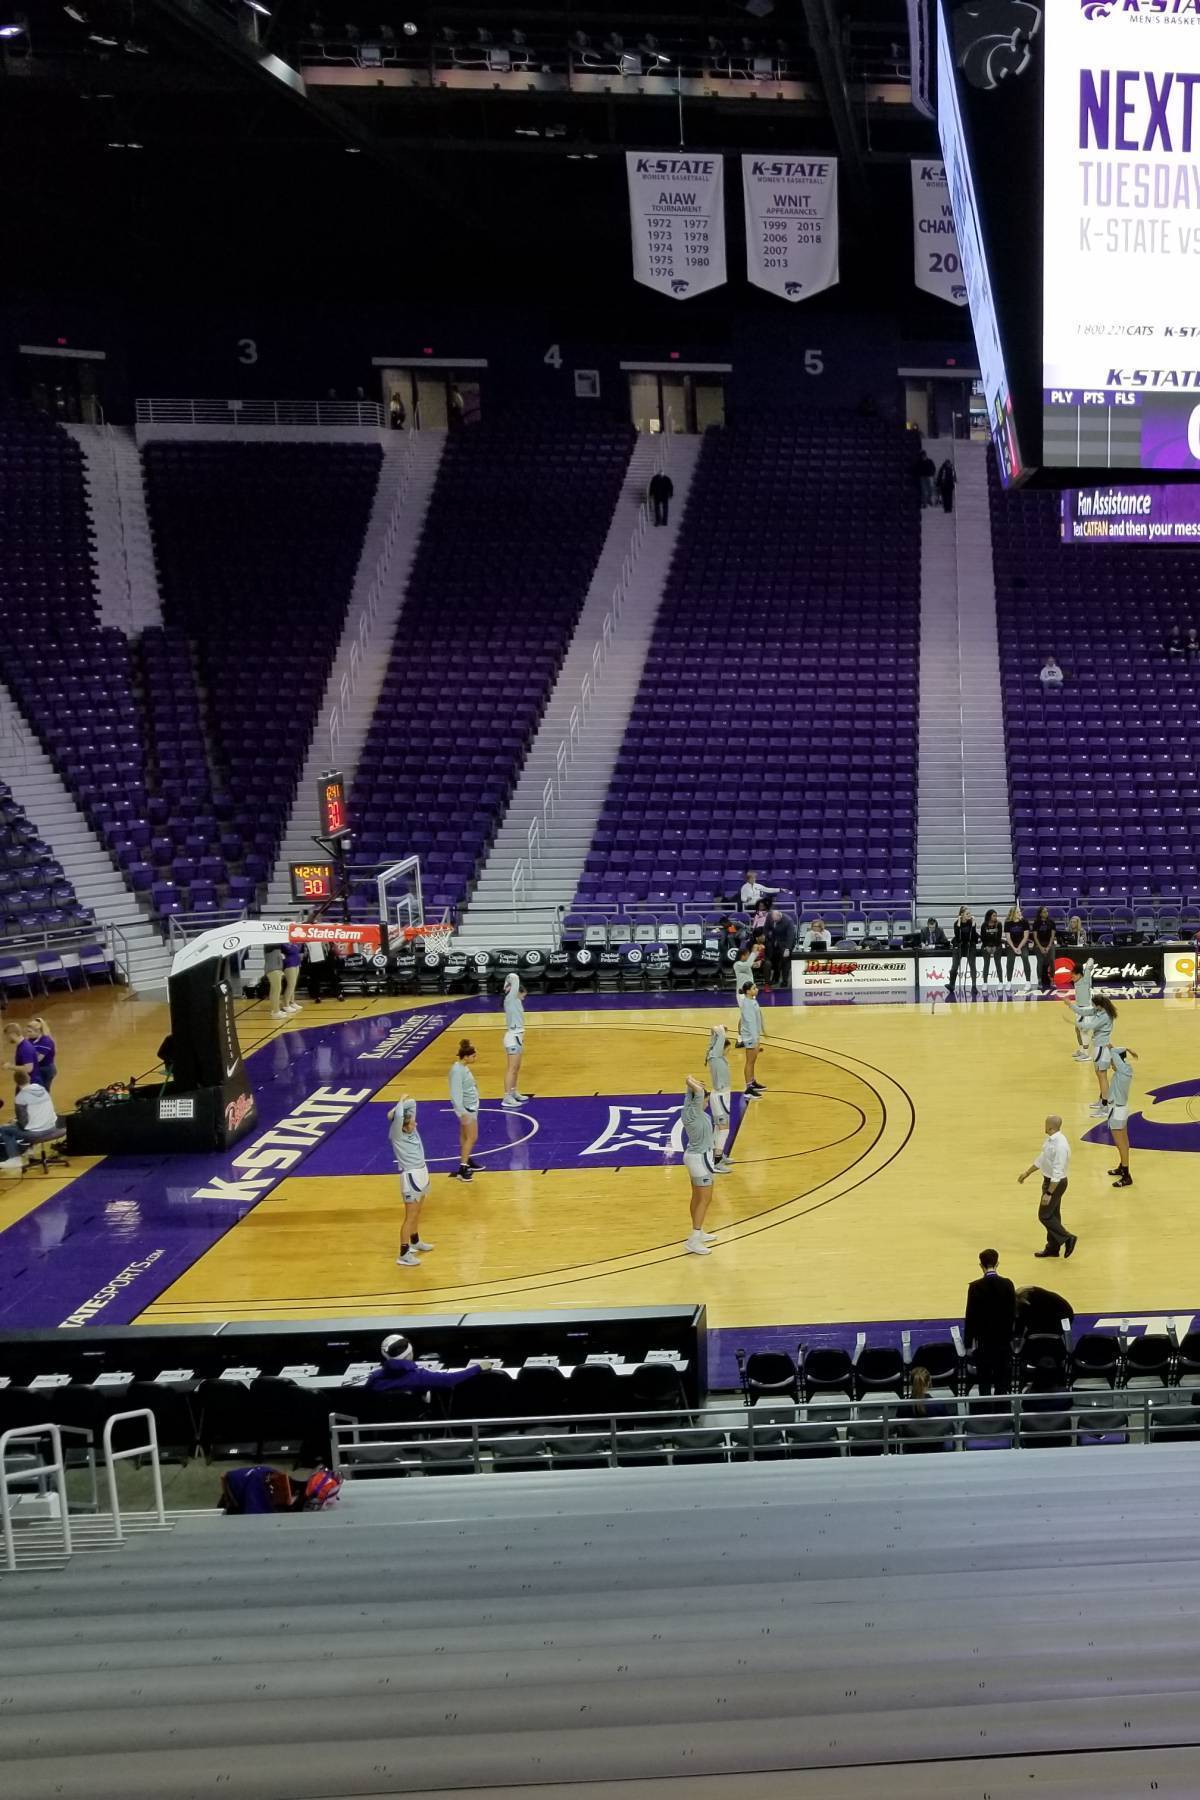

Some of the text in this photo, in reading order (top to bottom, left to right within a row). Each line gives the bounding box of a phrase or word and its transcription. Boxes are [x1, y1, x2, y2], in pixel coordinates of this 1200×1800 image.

[1130, 14, 1161, 24] MEN'S
[636, 159, 715, 175] K-STATE
[752, 161, 830, 177] K-STATE
[659, 192, 696, 205] AIAW
[773, 194, 812, 208] WNIT
[652, 205, 702, 213] TOURNAMENT
[766, 207, 818, 216] APPEARANCES
[648, 219, 708, 229] 1972 1977
[763, 221, 822, 231] 1999 2015
[648, 231, 709, 241] 1973 1978
[762, 233, 822, 244] 2006 2018
[1080, 218, 1171, 255] K-STATE
[649, 243, 709, 254] 1974 1979
[763, 246, 788, 255] 2007
[649, 255, 710, 266] 1975 1980
[764, 258, 788, 268] 2013
[649, 267, 674, 277] 1976
[238, 338, 258, 364] 3
[543, 344, 563, 369] 4
[804, 349, 824, 375] 5
[1050, 391, 1136, 405] PLY PTS FLS
[1077, 489, 1152, 516] Fan Assistance
[1083, 521, 1108, 536] CATFAN
[1109, 520, 1125, 537] and
[1126, 520, 1147, 536] then
[1149, 523, 1173, 540] your
[294, 866, 329, 878] 42:41
[303, 879, 323, 895] 30
[1120, 962, 1154, 977] Hut
[192, 1085, 373, 1202] K-STATE
